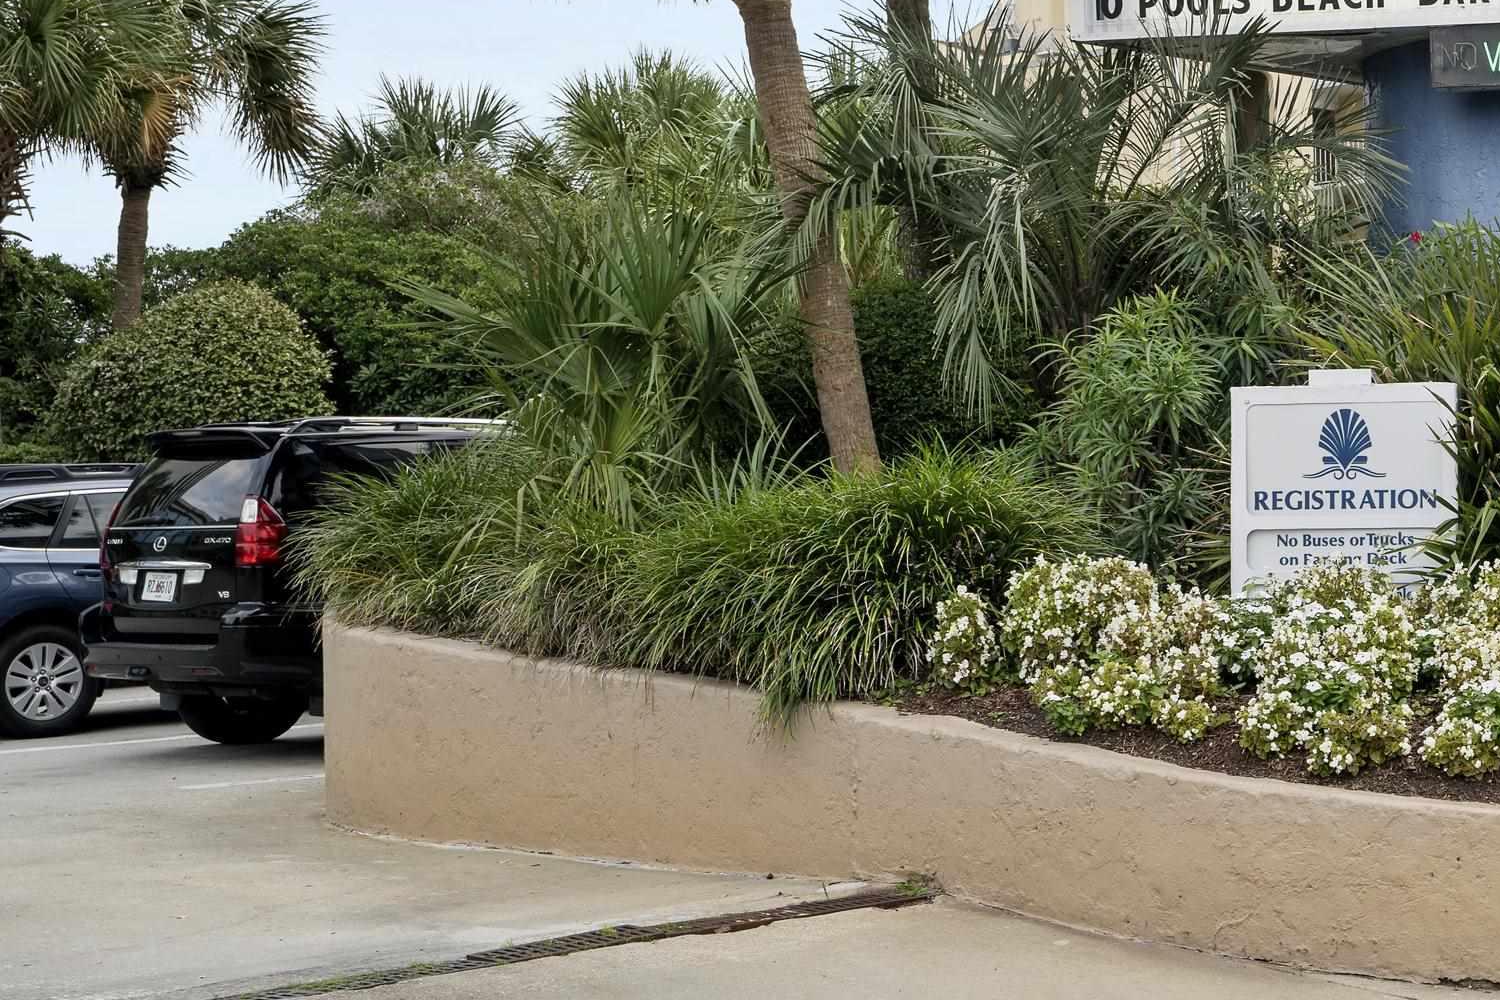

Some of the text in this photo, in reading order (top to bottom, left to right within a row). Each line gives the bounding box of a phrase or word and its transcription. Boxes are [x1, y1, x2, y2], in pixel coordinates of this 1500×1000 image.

[1440, 42, 1478, 71] NO
[1253, 489, 1437, 511] REGISTRATION
[1276, 531, 1415, 547] No Buses or Trucks
[1279, 551, 1408, 566] on Parn Deck
